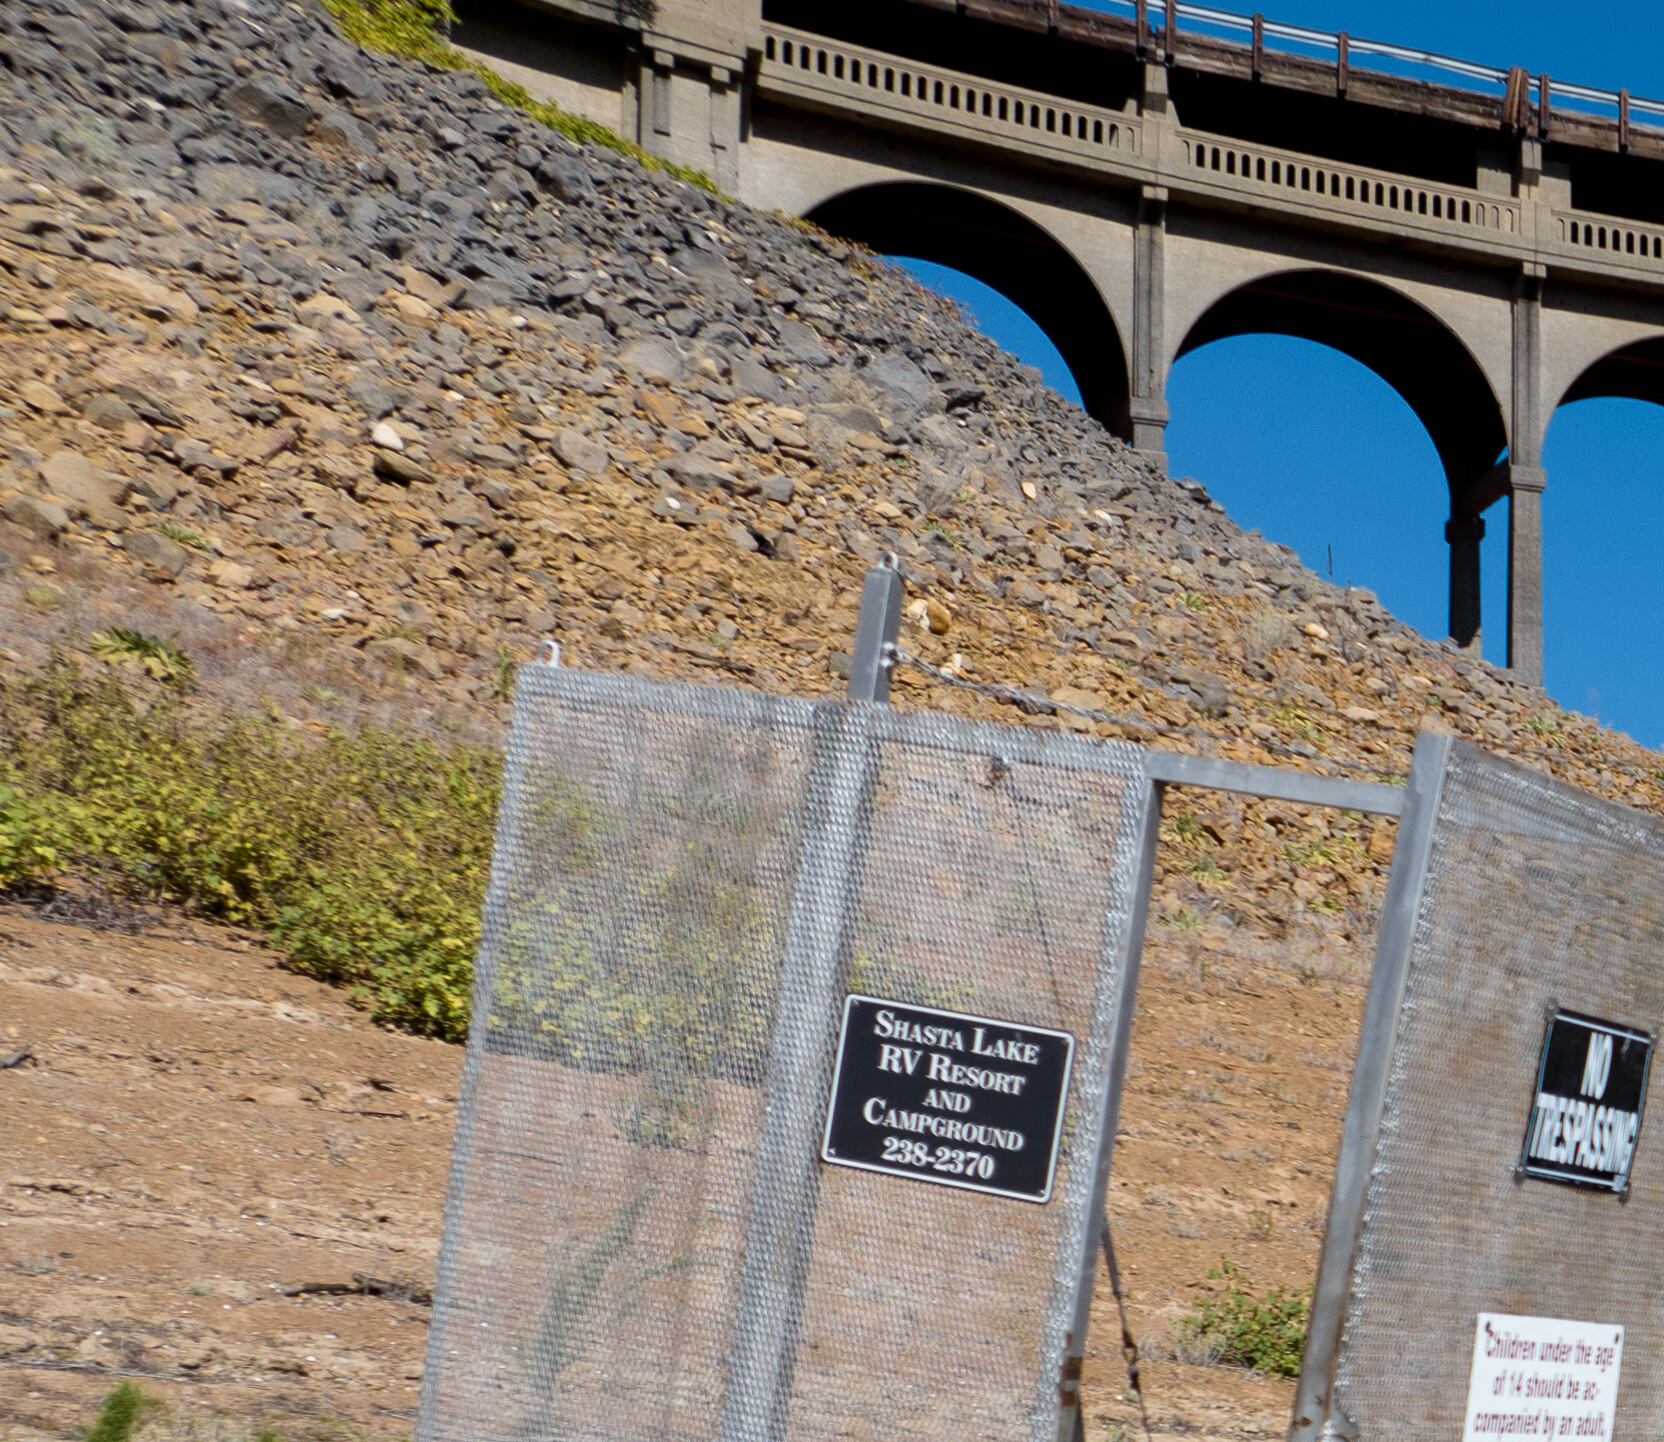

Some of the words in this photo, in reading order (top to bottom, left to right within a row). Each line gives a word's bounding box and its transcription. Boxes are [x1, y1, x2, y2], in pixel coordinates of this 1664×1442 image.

[878, 1044, 921, 1076] RV
[1580, 1031, 1613, 1100] NO
[1529, 1092, 1638, 1175] TRESPASSING
[881, 1136, 995, 1180] 238-2370
[1484, 1328, 1536, 1359] Children
[1540, 1337, 1572, 1363] under
[1575, 1338, 1592, 1364] the
[1595, 1345, 1615, 1372] age
[1492, 1370, 1508, 1396] of
[1510, 1370, 1525, 1397] 14
[1525, 1371, 1564, 1398] should
[1566, 1373, 1579, 1400] be
[1473, 1408, 1541, 1440] companied
[1543, 1410, 1558, 1441] by
[1558, 1416, 1574, 1436] an
